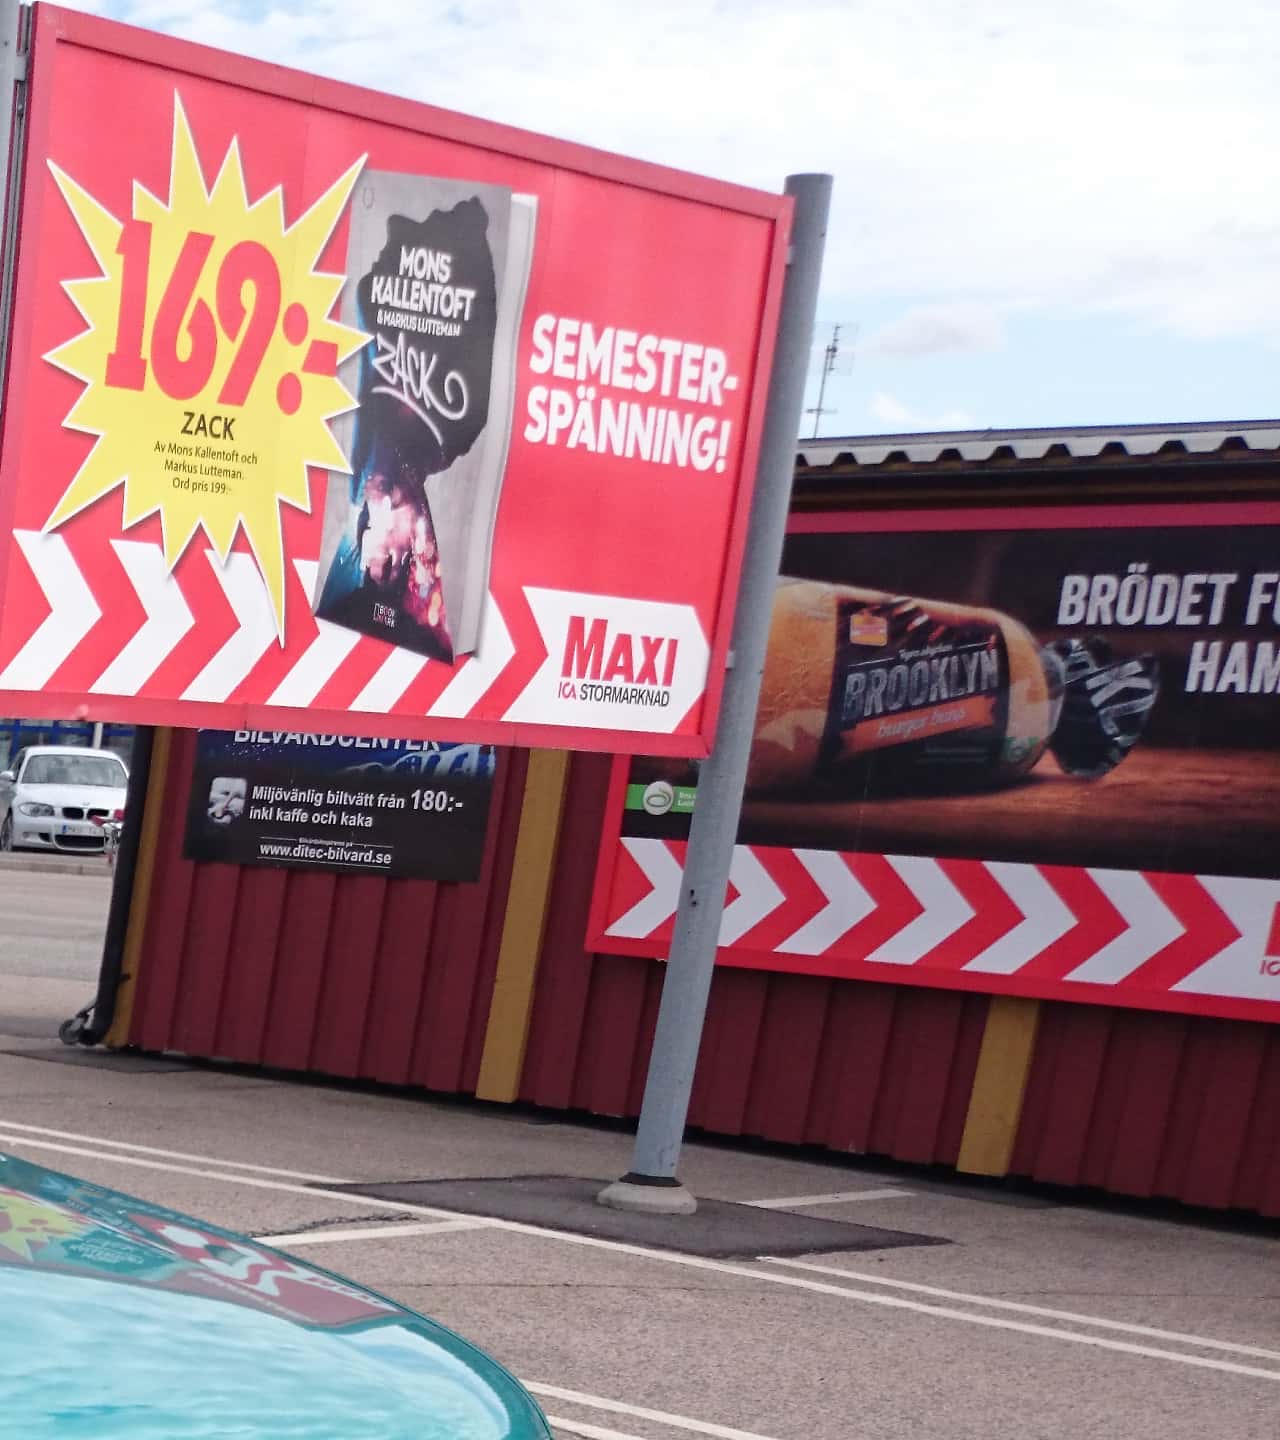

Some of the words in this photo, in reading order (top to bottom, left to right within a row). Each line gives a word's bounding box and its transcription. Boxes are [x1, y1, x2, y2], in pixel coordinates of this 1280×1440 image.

[399, 245, 452, 283] MONS
[371, 275, 476, 321] KALLENTOFT
[104, 218, 339, 416] 169:-
[383, 310, 417, 331] MARKUS
[417, 317, 461, 337] LUTTEMAN
[529, 314, 738, 406] SEMESTER-
[180, 411, 236, 441] ZACK
[524, 385, 731, 473] SPÄNNING!
[154, 440, 166, 453] Av
[167, 443, 193, 457] Mons
[195, 446, 239, 464] Kallentoft
[241, 452, 258, 464] och
[164, 459, 198, 474] Markus
[172, 477, 190, 489] Ord
[192, 480, 209, 494] pris
[1057, 562, 1238, 626] BRÖDET
[560, 615, 679, 687] MAXI
[558, 682, 577, 700] ICA
[579, 683, 670, 707] STORMARKNAD
[841, 649, 999, 721] BROOKLYN
[251, 786, 324, 807] Miljövänlig
[326, 790, 374, 807] biltvätt
[377, 793, 406, 809] från
[410, 788, 464, 812] 180:-
[249, 806, 273, 821] inkl
[276, 807, 309, 823] kaffe
[311, 810, 338, 825] och
[340, 811, 374, 828] kaka
[259, 842, 393, 865] www.ditec-bilvard.se
